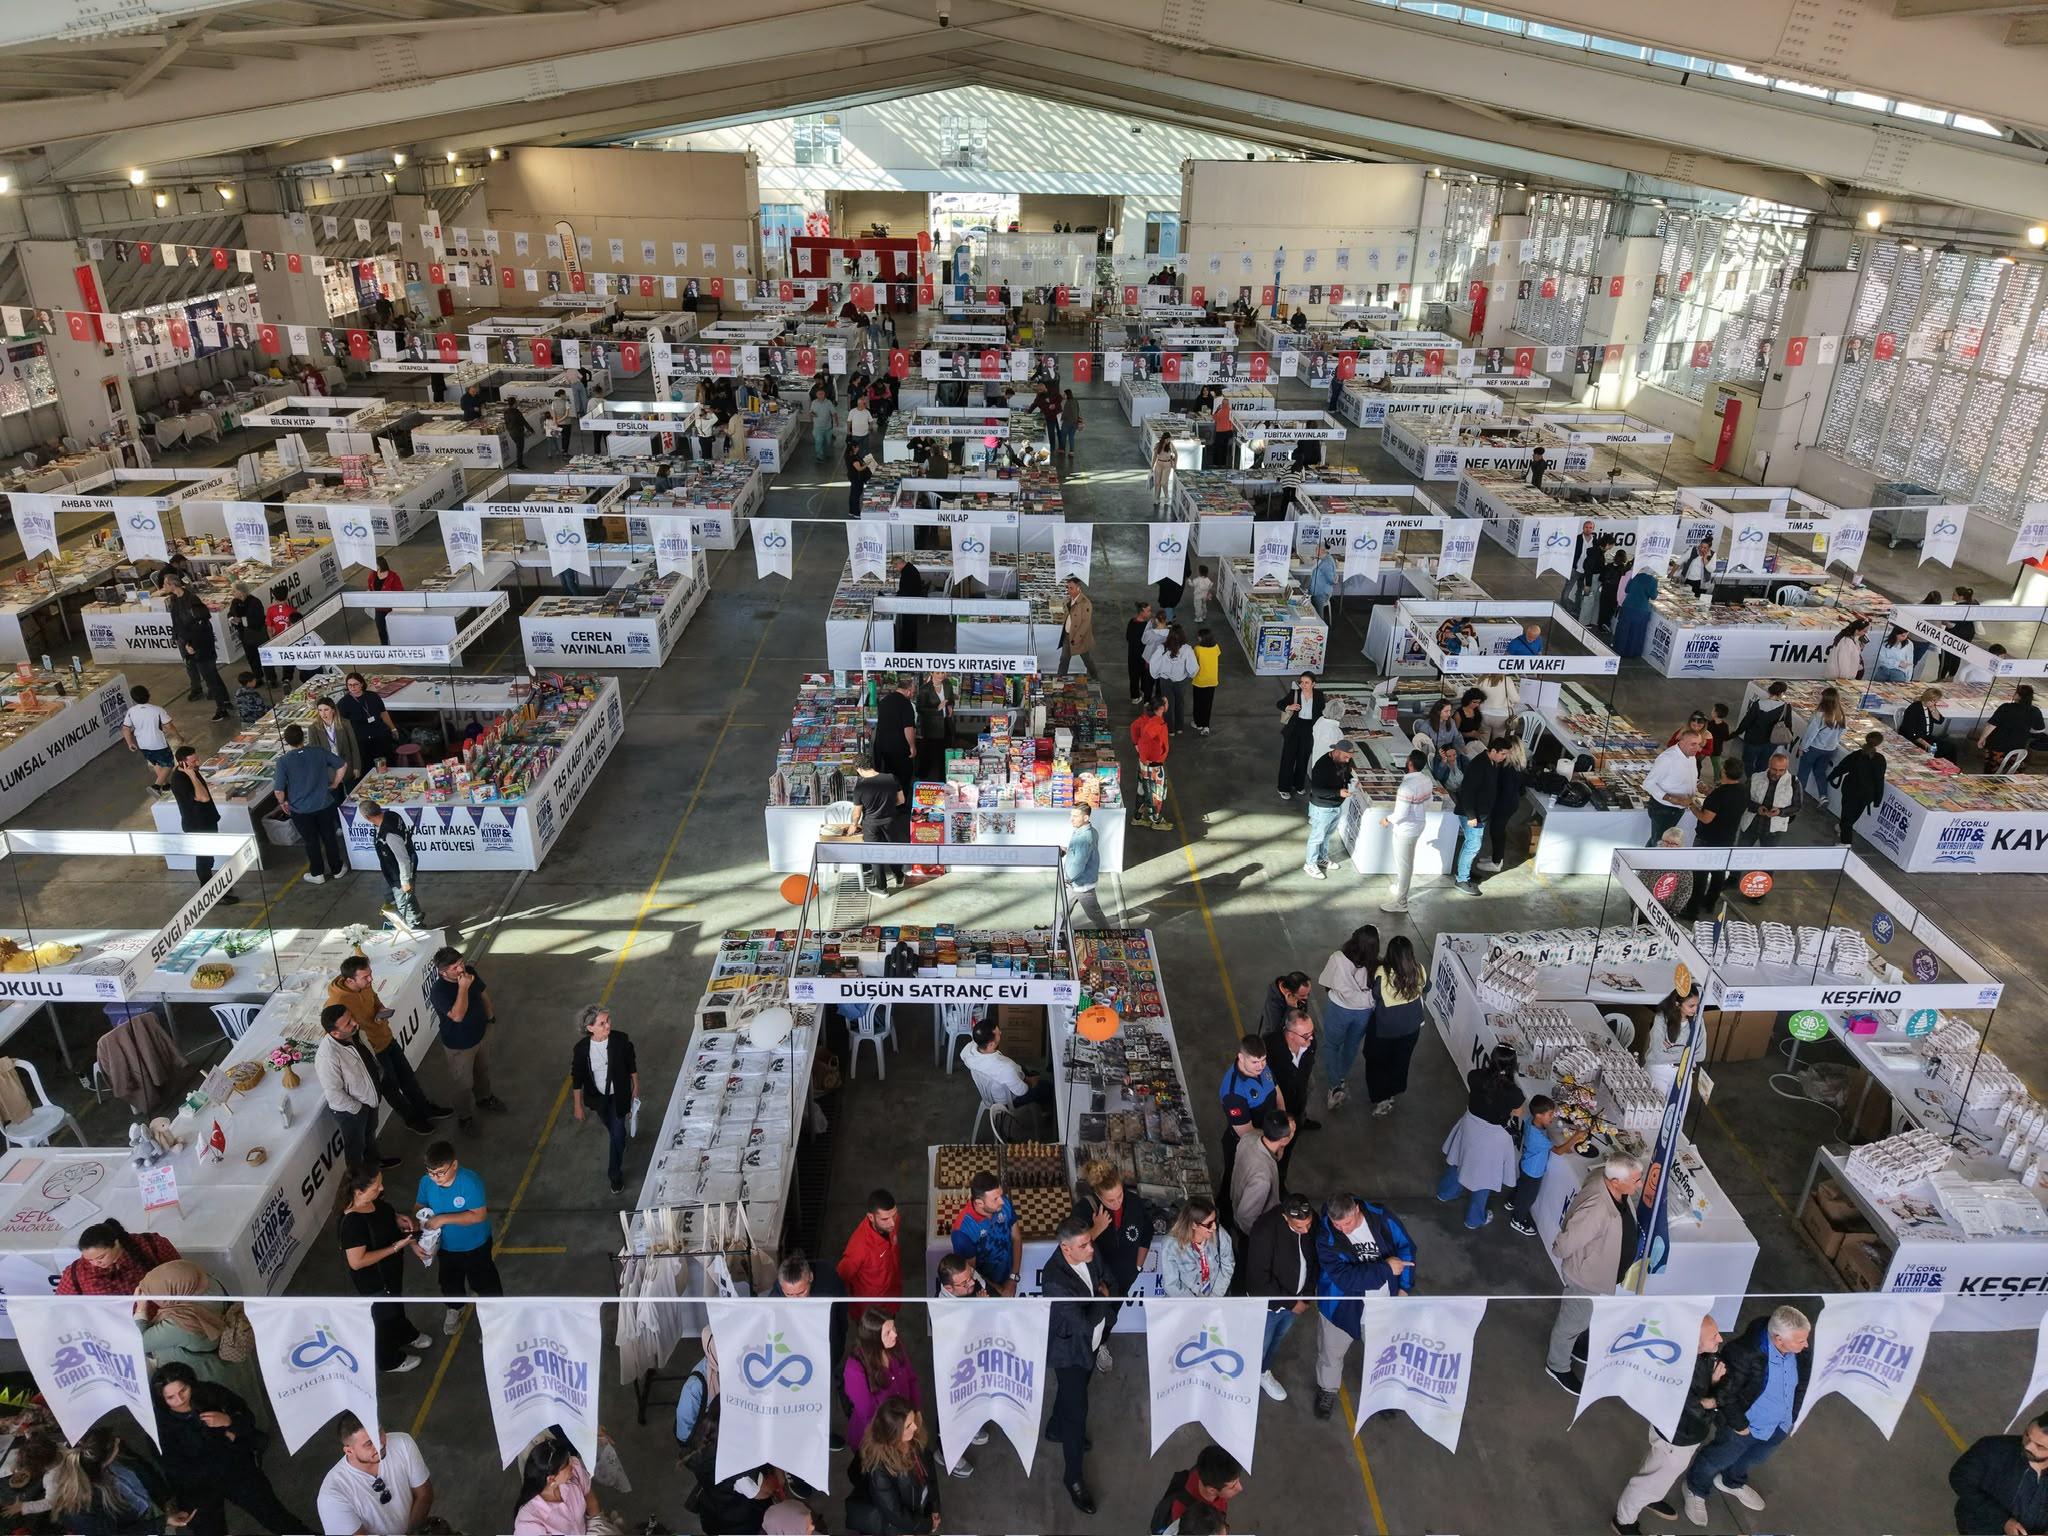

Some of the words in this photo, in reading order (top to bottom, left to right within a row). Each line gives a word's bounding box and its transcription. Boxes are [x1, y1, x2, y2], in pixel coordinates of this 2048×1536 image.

[1231, 401, 1255, 411] KİTAP
[270, 416, 297, 426] BİLEN
[298, 416, 316, 426] KİTAP
[616, 420, 649, 430] EPSİLON
[1264, 430, 1292, 439] TÜBİTAK
[1293, 431, 1328, 439] YAYINLARI
[1606, 433, 1637, 442] PİNGOLA
[435, 446, 474, 455] KİTAPKOLİK
[1465, 458, 1490, 469] NEF
[182, 487, 199, 500] AHBAB
[197, 477, 224, 494] YAYINCILIK
[61, 499, 92, 508] AHBAB
[317, 520, 331, 530] BİL
[1385, 518, 1423, 528] AYINEVİ
[134, 624, 173, 636] AHBAB
[1915, 621, 1942, 643] KAYRA
[571, 631, 612, 642] CEREN
[125, 638, 179, 649] YAYINCIL
[560, 644, 626, 655] YAYINLARI
[278, 651, 295, 661] TAŞ
[296, 649, 321, 660] KAĞIT
[324, 650, 355, 659] MAKAS
[357, 650, 386, 659] DUYGU
[388, 647, 426, 659] ATÖLYESİ
[884, 657, 922, 669] ARDEN
[926, 658, 955, 670] TOYS
[959, 656, 1016, 671] KIRTASİYE
[1498, 659, 1524, 671] CEM
[1528, 659, 1565, 671] VAKFI
[45, 716, 99, 765] YAYINCILIK
[553, 771, 567, 797] TAŞ
[566, 743, 583, 776] KAĞIT
[582, 710, 606, 752] MAKAS
[559, 783, 581, 819] DUYGU
[581, 733, 607, 789] ATÖLYESİ
[439, 825, 476, 836] MAKAS
[430, 838, 475, 852] ATÖLYESİ
[151, 918, 182, 964] SEVGİ
[184, 867, 235, 933] ANAOKULU
[1645, 898, 1680, 947] KEŞFİNO
[840, 981, 903, 1002] DÜŞÜN
[908, 982, 994, 1003] SATRANÇ
[998, 981, 1029, 999] EVİ
[1821, 988, 1901, 1008] KEŞFİNO
[301, 1129, 345, 1207] SEVG
[1671, 1160, 1695, 1202] Keşfino
